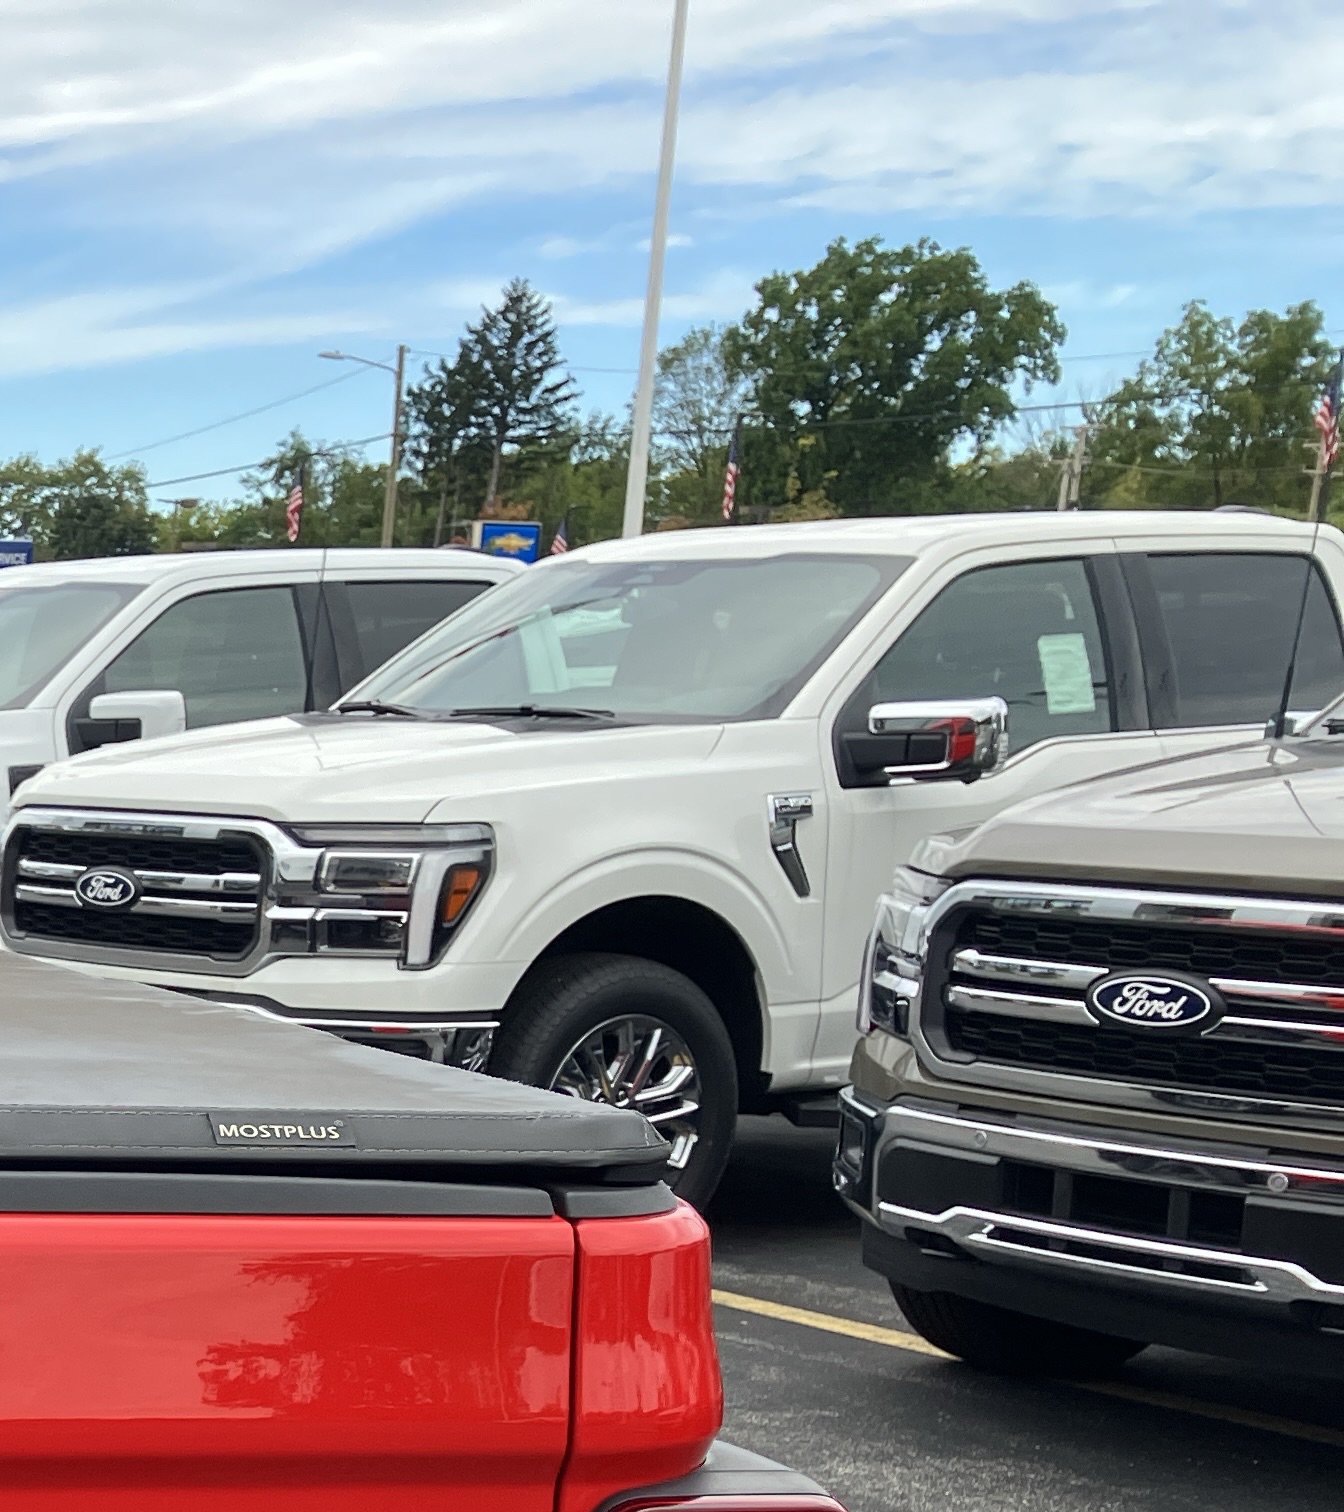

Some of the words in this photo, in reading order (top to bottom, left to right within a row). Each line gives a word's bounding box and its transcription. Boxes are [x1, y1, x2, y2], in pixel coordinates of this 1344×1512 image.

[86, 875, 124, 900] Ford
[1113, 982, 1188, 1018] Ford
[218, 1124, 340, 1139] MOSTPLUS
